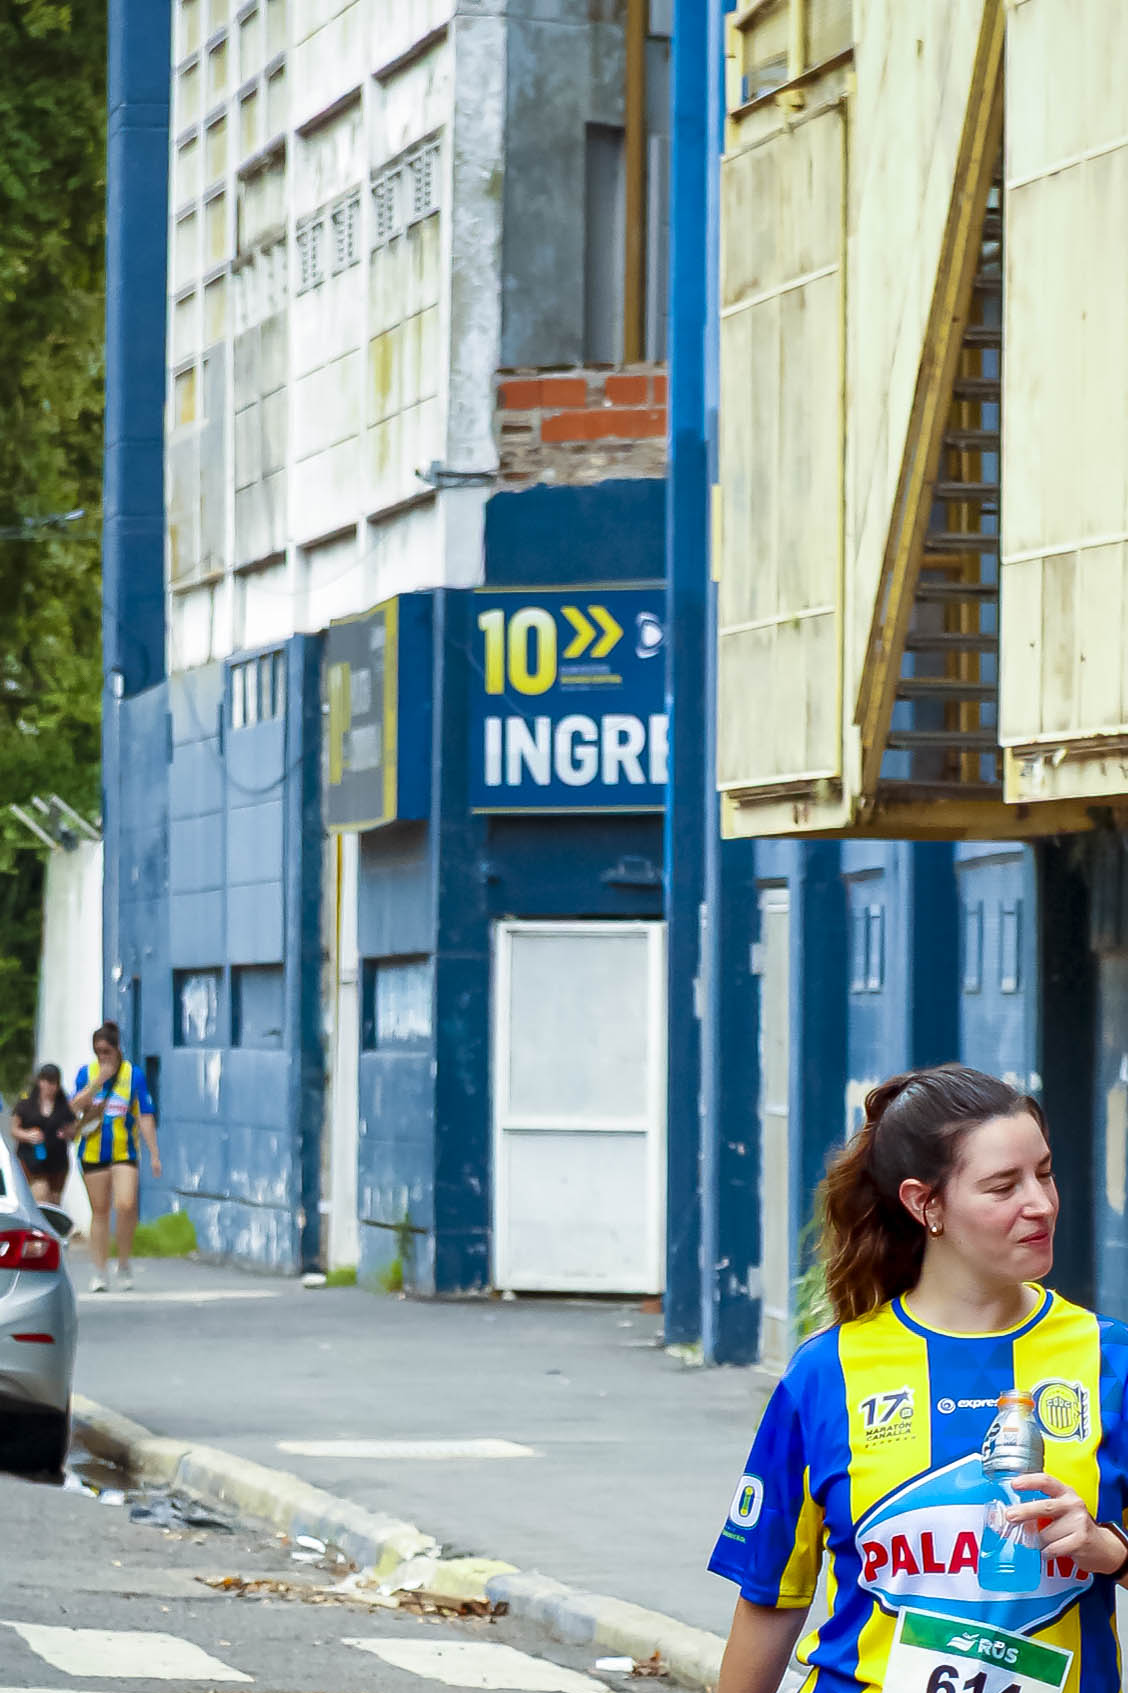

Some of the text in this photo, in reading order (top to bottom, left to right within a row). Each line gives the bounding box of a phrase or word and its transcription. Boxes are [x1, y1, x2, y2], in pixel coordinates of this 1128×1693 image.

[478, 606, 557, 695] 10
[957, 1398, 998, 1409] expres
[865, 1421, 912, 1437] MARATÓN
[866, 1429, 912, 1442] CANALLA
[977, 1637, 1021, 1664] RUS
